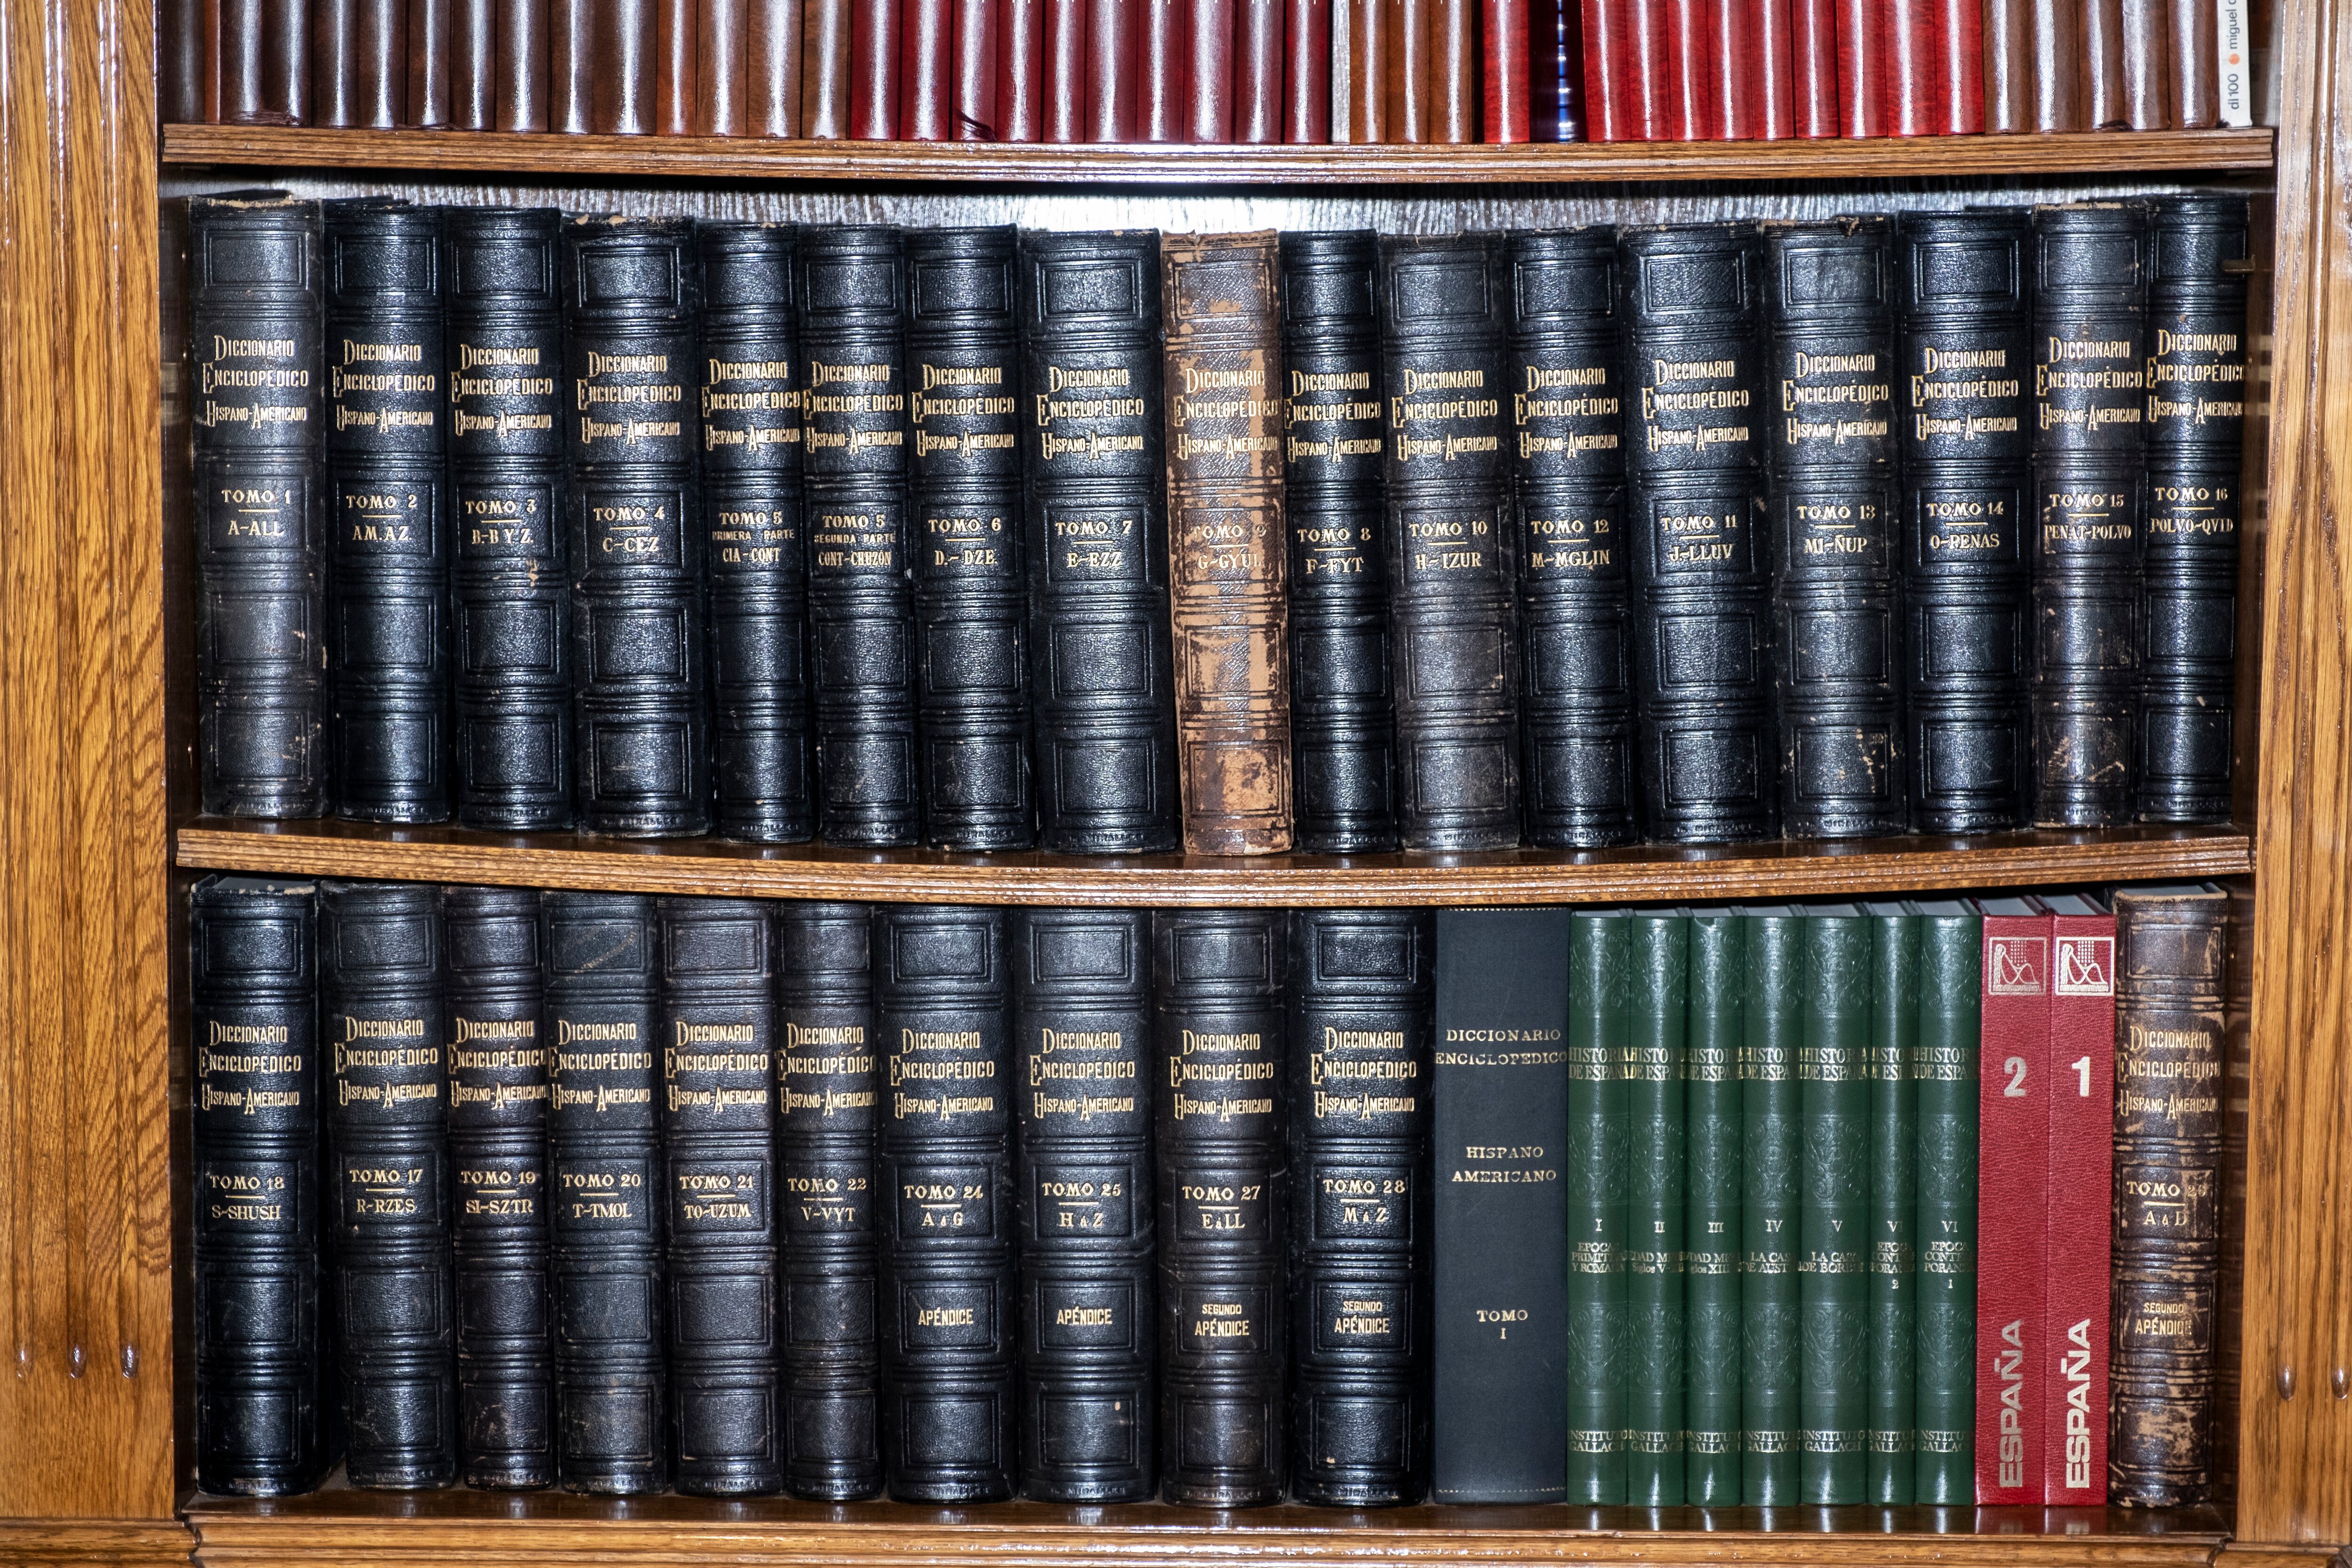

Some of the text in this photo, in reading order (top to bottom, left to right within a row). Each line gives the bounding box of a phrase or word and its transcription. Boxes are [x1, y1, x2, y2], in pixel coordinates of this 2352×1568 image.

[2225, 9, 2240, 49] miguel
[214, 335, 294, 360] DICCIONARIO
[2049, 337, 2130, 363] DICCIONARIO
[588, 352, 667, 377] DICCIONARIO
[1796, 352, 1875, 378] DICCIONARIO
[1925, 348, 2005, 373] DICCIONARIO
[923, 364, 1001, 389] DICCIONARIO
[1049, 366, 1130, 392] DICCIONARIO
[1655, 359, 1734, 386] DICCIONARIO
[1405, 369, 1483, 395] DICCIONARIO
[207, 400, 307, 430] HISPANO-AMERICANO
[2040, 403, 2140, 430] HISPANO-AMERICANO
[582, 417, 680, 445] HISPANO-AMERICANO
[1788, 418, 1887, 444] HISPANO-AMERICANO
[1916, 413, 2017, 441] HISPANO-AMERICANO
[916, 430, 1014, 457] HISPANO-AMERICANO
[1041, 432, 1143, 459] HISPANO-AMERICANO
[1648, 425, 1748, 451] HISPANO-AMERICANO
[1398, 433, 1497, 461] HISPANO-AMERICANO
[346, 494, 417, 509] TOMO 2
[2155, 488, 2227, 501] TOMO 16
[466, 499, 536, 514] TOMO 3
[594, 507, 664, 521] TOMO 4
[1927, 502, 2003, 515] TOMO 14
[719, 511, 782, 525] TOMO 5
[822, 514, 885, 528] TOMO 5
[1661, 515, 1737, 531] TOMO 11
[228, 521, 285, 535] A-ALL
[1055, 520, 1132, 535] TOMO 7
[1190, 525, 1243, 538] TOMO
[1531, 519, 1609, 534] TOMO 12
[712, 530, 795, 541] PRIMERA PARTE
[814, 532, 895, 543] SEGUNDA PARTE
[1297, 528, 1371, 542] TOMO 8
[603, 536, 660, 553] C-CEZ
[1804, 534, 1867, 554] MI-ÑUP
[723, 548, 779, 562] CIA-CONT
[1067, 551, 1122, 568] E-EZZ
[1416, 552, 1482, 570] H-IZUR
[1532, 550, 1610, 569] M-MGLIN
[1306, 557, 1363, 574] F-FYT
[210, 1021, 287, 1046] DICCIONARIO
[346, 1017, 423, 1041] DICCIONARIO
[559, 1020, 636, 1045] DICCIONARIO
[677, 1021, 753, 1045] DICCIONARIO
[1446, 1029, 1560, 1042] DICCIONARIO
[1043, 1029, 1120, 1053] DICCIONARIO
[1325, 1027, 1403, 1052] DICCIONARIO
[1436, 1051, 1567, 1065] ENCICLOPEDICO
[1569, 1065, 1583, 1079] DE
[1630, 1065, 1644, 1080] DE
[1805, 1065, 1820, 1080] DE
[2004, 1056, 2027, 1097] 2
[2072, 1056, 2090, 1097] 1
[202, 1085, 299, 1114] HISPANO-AMERICANO
[339, 1080, 436, 1108] HISPANO-AMERICANO
[552, 1084, 650, 1111] HISPANO-AMERICANO
[669, 1085, 766, 1112] HISPANO-AMERICANO
[1034, 1093, 1133, 1121] HISPANO-AMERICANO
[1315, 1091, 1414, 1119] HISPANO-AMERICANO
[1466, 1147, 1543, 1159] HISPANO
[210, 1175, 285, 1189] TOMO 18
[461, 1171, 535, 1184] TOMO 19
[680, 1175, 753, 1189] TOMO 21
[1452, 1170, 1556, 1182] AMERICANO
[788, 1178, 866, 1192] TOMO 22
[905, 1185, 983, 1199] TOMO 24
[1323, 1180, 1405, 1193] TOMO 28
[2127, 1181, 2180, 1196] TOMO
[1182, 1186, 1260, 1201] TOMO 27
[212, 1205, 281, 1220] S-SHUSH
[357, 1199, 415, 1213] R-RZES
[466, 1199, 534, 1214] SI-SZTR
[573, 1204, 632, 1218] T-TMOL
[684, 1204, 751, 1219] TO-UZUM
[802, 1208, 856, 1222] V-VYT
[1596, 1219, 1602, 1231] I
[1654, 1221, 1665, 1233] II
[1708, 1222, 1724, 1233] III
[1766, 1220, 1783, 1232] IV
[1832, 1220, 1843, 1232] V
[1942, 1220, 1957, 1232] VI
[1751, 1252, 1766, 1261] LA
[1812, 1252, 1828, 1261] LA
[1804, 1262, 1817, 1272] DE
[1892, 1280, 1899, 1289] 2
[1948, 1280, 1953, 1289] 1
[1202, 1304, 1241, 1315] SEGUNDO
[1343, 1301, 1382, 1312] SEGUNDO
[2144, 1302, 2185, 1313] SEGUNDO
[918, 1307, 974, 1326] APÉNDICE
[1057, 1306, 1112, 1325] APÉNDICE
[1477, 1310, 1528, 1322] TOMO
[1195, 1319, 1249, 1336] APÉNDICE
[1335, 1315, 1389, 1333] APÉNDICE
[2135, 1317, 2193, 1335] APÉNDICE
[1501, 1329, 1506, 1339] I
[1994, 1319, 2023, 1488] ESPAÑA
[2061, 1319, 2091, 1489] ESPAÑA
